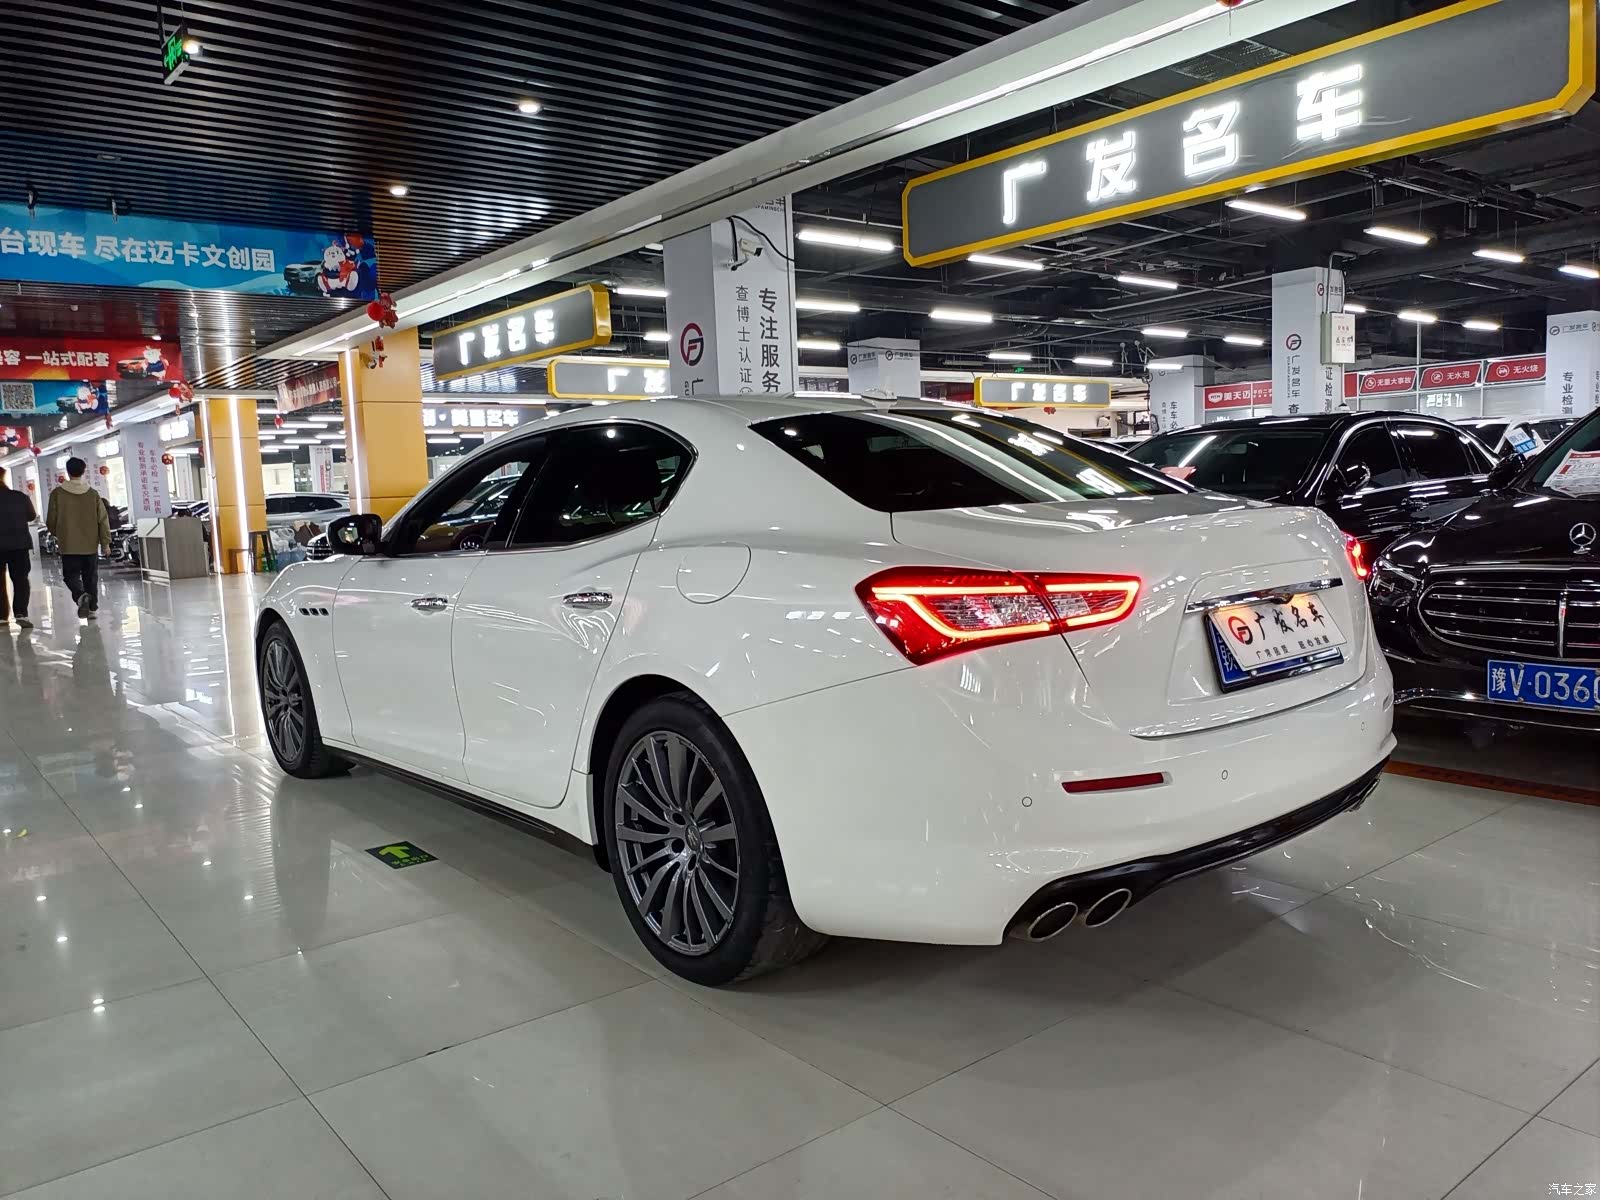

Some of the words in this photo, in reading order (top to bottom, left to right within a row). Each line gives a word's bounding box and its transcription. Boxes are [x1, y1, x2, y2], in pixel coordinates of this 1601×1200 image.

[1002, 64, 1363, 225] 广发名车
[0, 226, 87, 259] 台现车
[94, 235, 276, 273] 尽在迈卡文创园
[458, 309, 556, 366] 广发名车
[735, 285, 753, 384] 查博士认证
[758, 288, 781, 393] 专注服务
[0, 350, 20, 366] 容
[25, 350, 109, 367] 一站式配套
[1446, 370, 1471, 380] 无水泡
[1513, 364, 1539, 374] 无火烧
[1254, 602, 1326, 641] 广发名车
